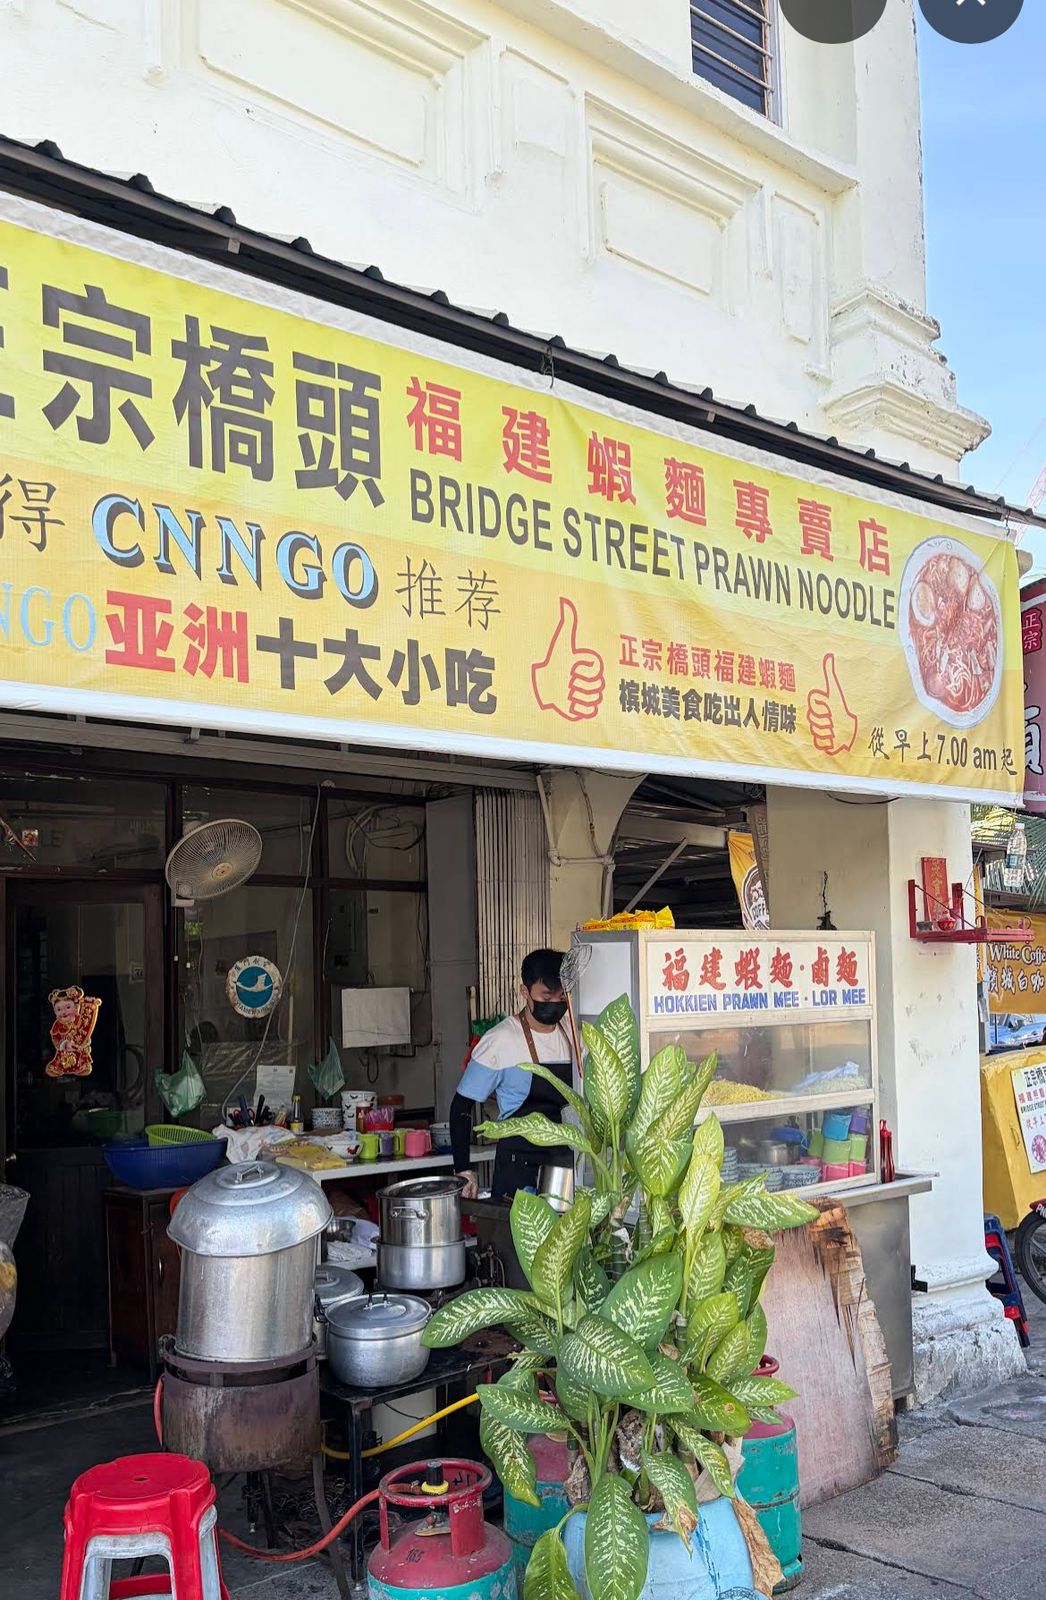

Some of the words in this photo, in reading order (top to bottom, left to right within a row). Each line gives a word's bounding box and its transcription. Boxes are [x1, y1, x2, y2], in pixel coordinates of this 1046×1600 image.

[91, 493, 380, 610] CNNGO
[394, 555, 502, 632] 推荐
[409, 468, 553, 552] BRIDGE
[562, 507, 686, 580] STREET
[694, 545, 791, 606] PRAWN
[799, 570, 895, 630] NOODLE
[618, 634, 797, 693] 正宗橋頭福建蝦麵
[988, 943, 1021, 962] White
[654, 994, 718, 1013] HOKKIEN
[723, 992, 768, 1011] PRAWN
[773, 991, 799, 1008] MEE
[812, 990, 837, 1007] LOR
[842, 989, 866, 1005] MEE
